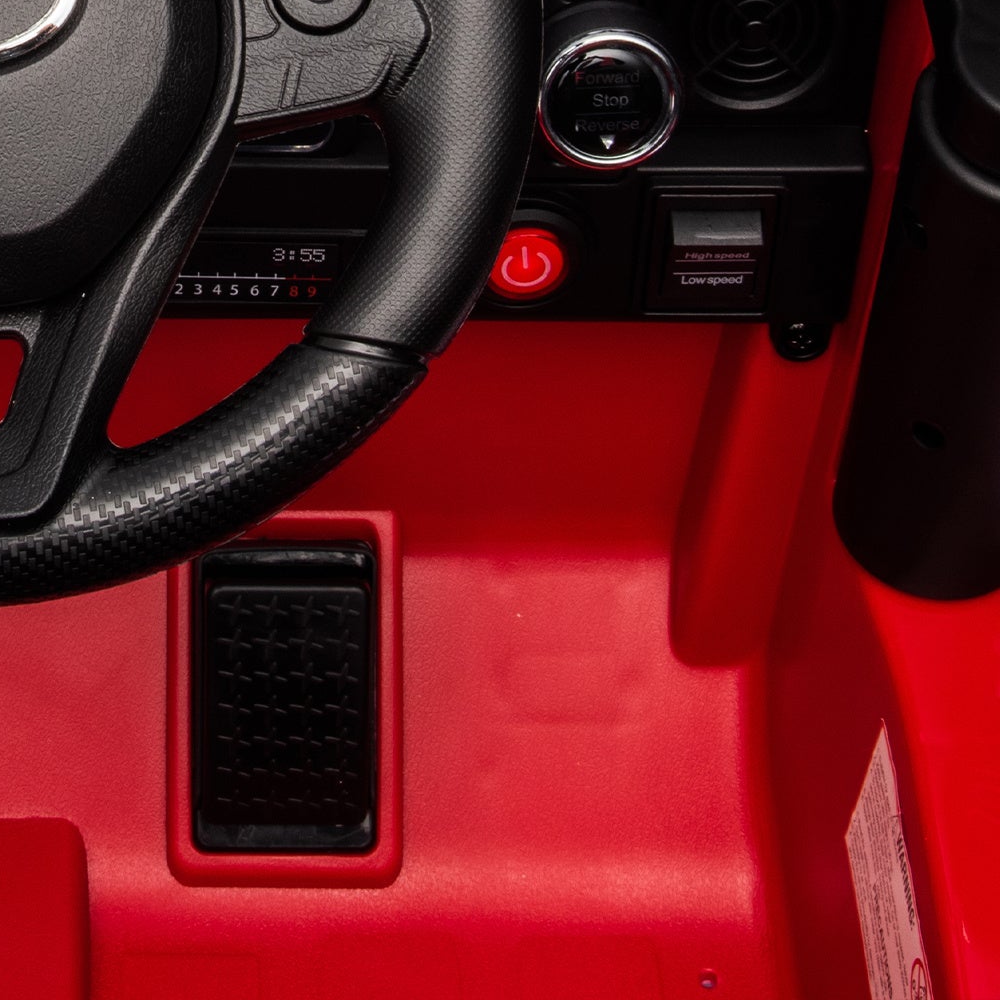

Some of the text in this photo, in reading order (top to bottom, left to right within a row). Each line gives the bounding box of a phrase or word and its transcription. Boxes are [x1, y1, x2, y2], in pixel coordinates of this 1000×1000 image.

[575, 70, 640, 85] Forward
[592, 93, 629, 108] Stop
[272, 247, 326, 263] 3:55
